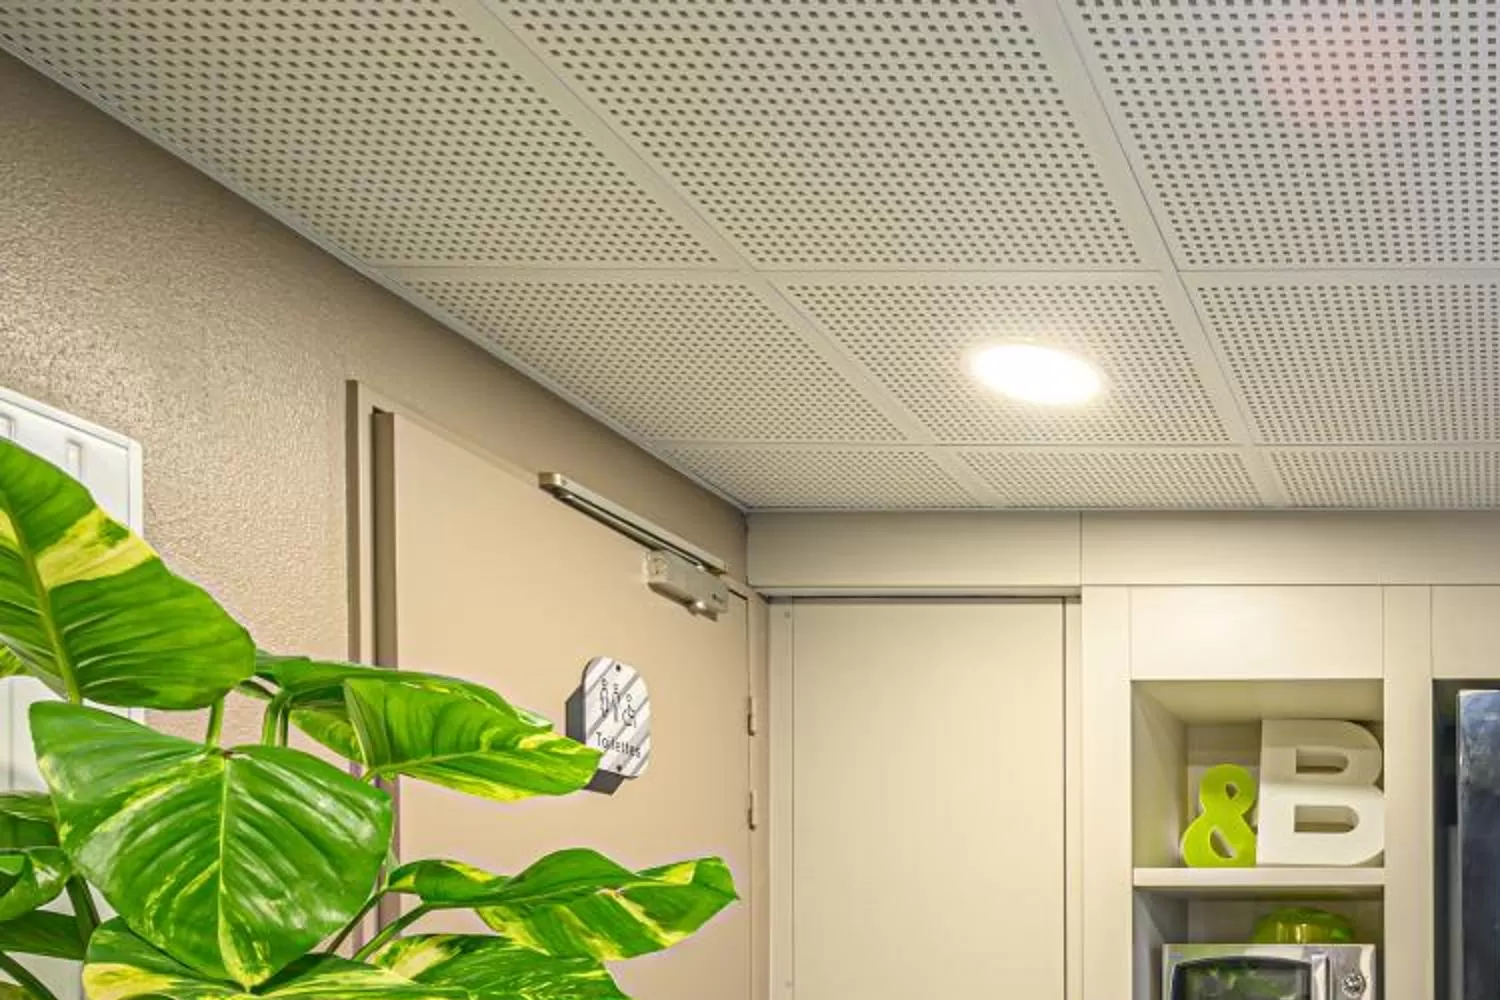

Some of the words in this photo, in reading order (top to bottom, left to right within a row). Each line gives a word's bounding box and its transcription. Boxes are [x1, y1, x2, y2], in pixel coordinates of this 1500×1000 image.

[596, 731, 641, 758] Toilettes
[1180, 763, 1257, 868] &
[1256, 718, 1385, 866] B
